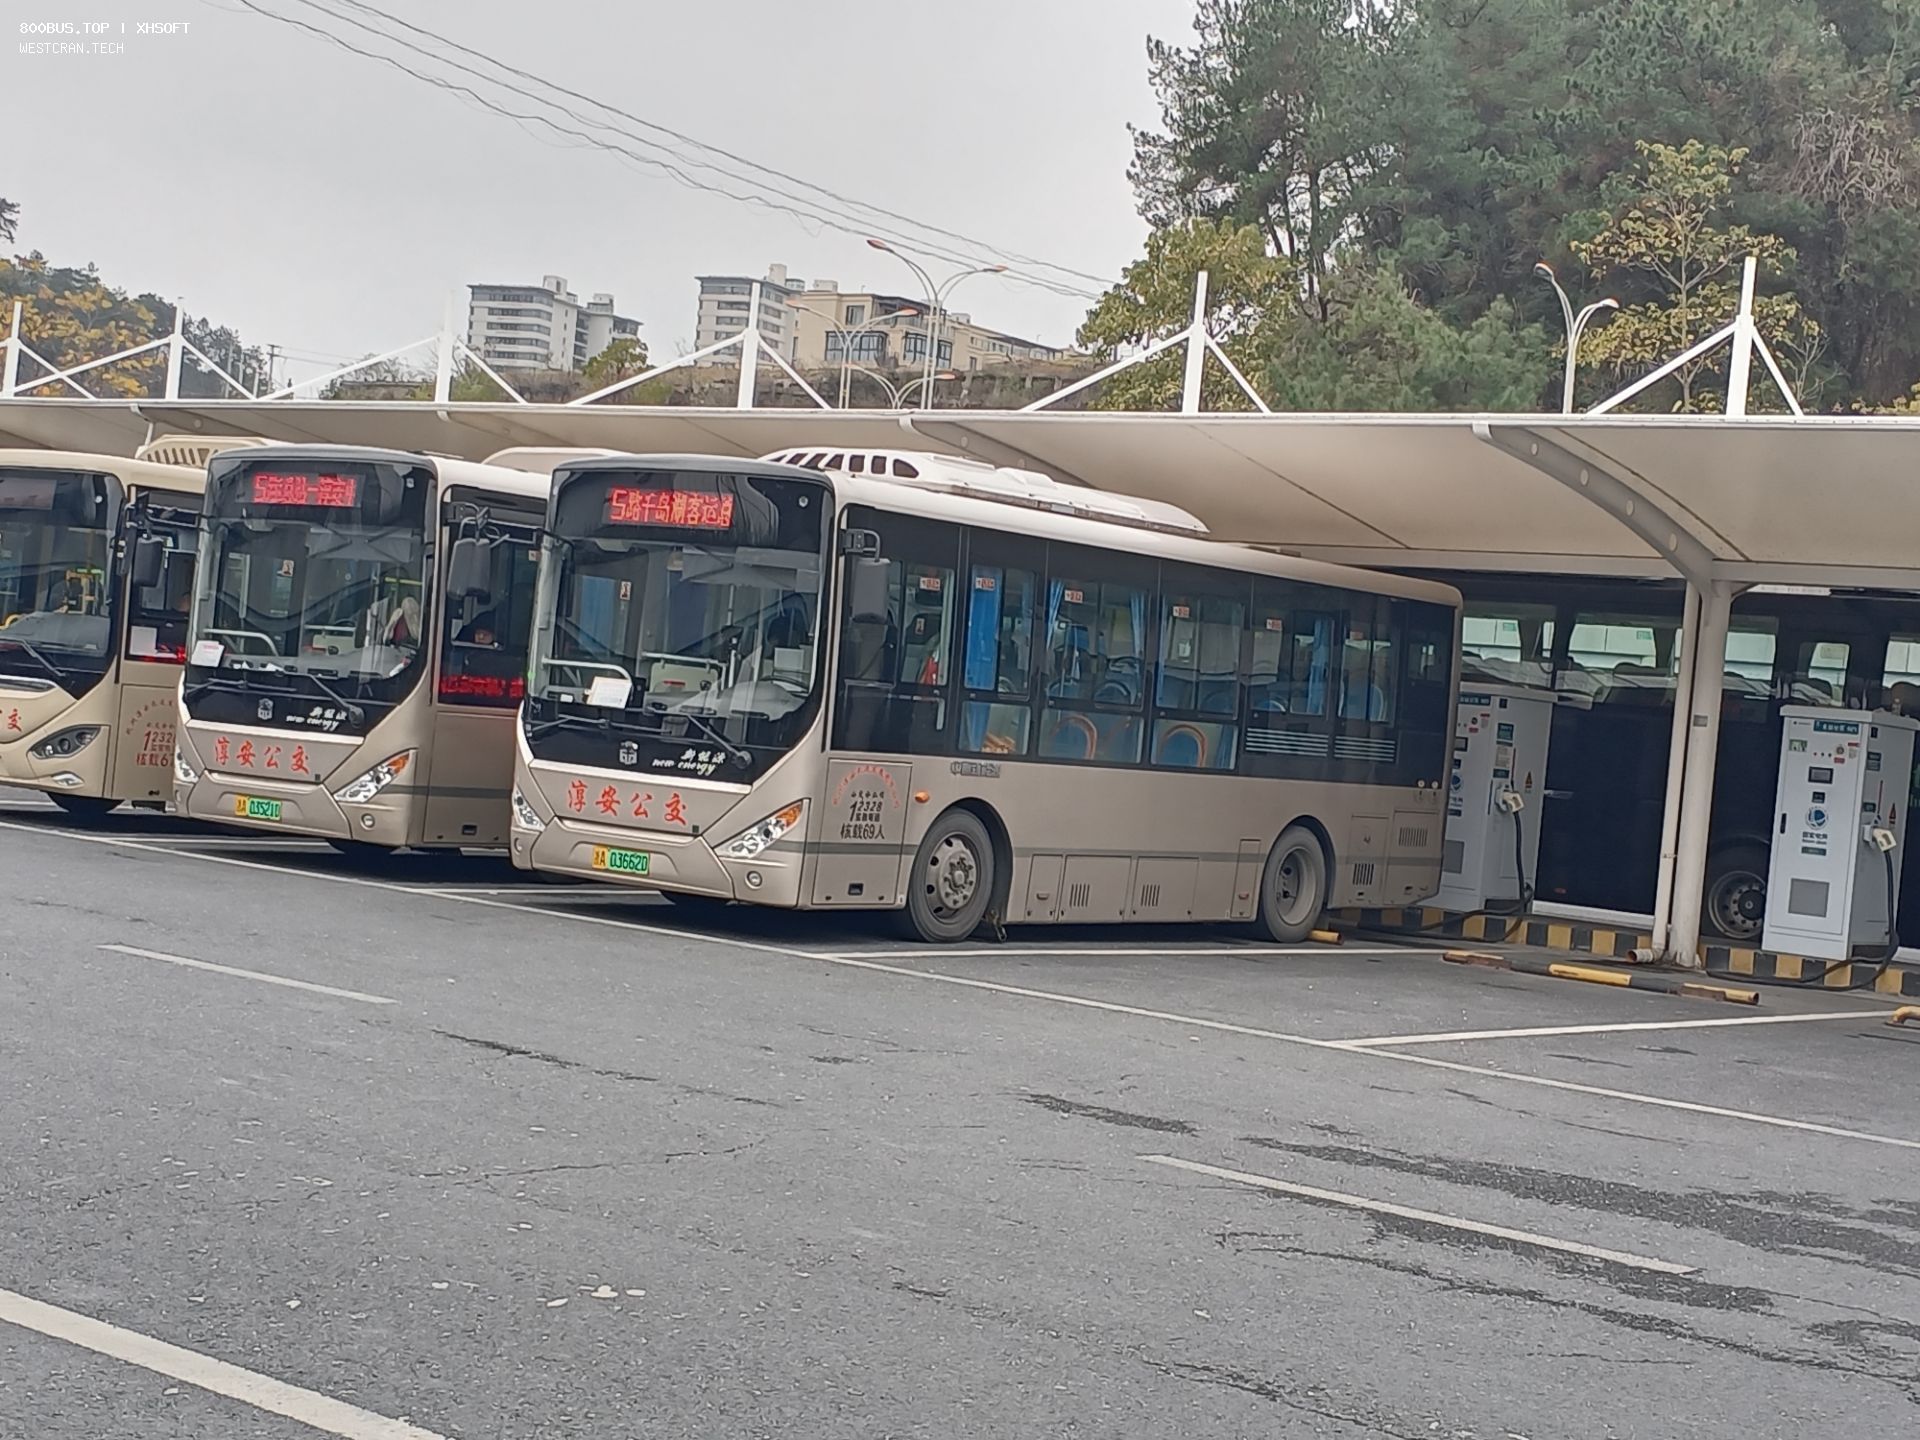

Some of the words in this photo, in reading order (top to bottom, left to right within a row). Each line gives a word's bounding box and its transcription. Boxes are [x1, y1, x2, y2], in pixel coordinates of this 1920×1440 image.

[215, 736, 309, 774] 淳安公交
[568, 780, 687, 825] 淳安公交
